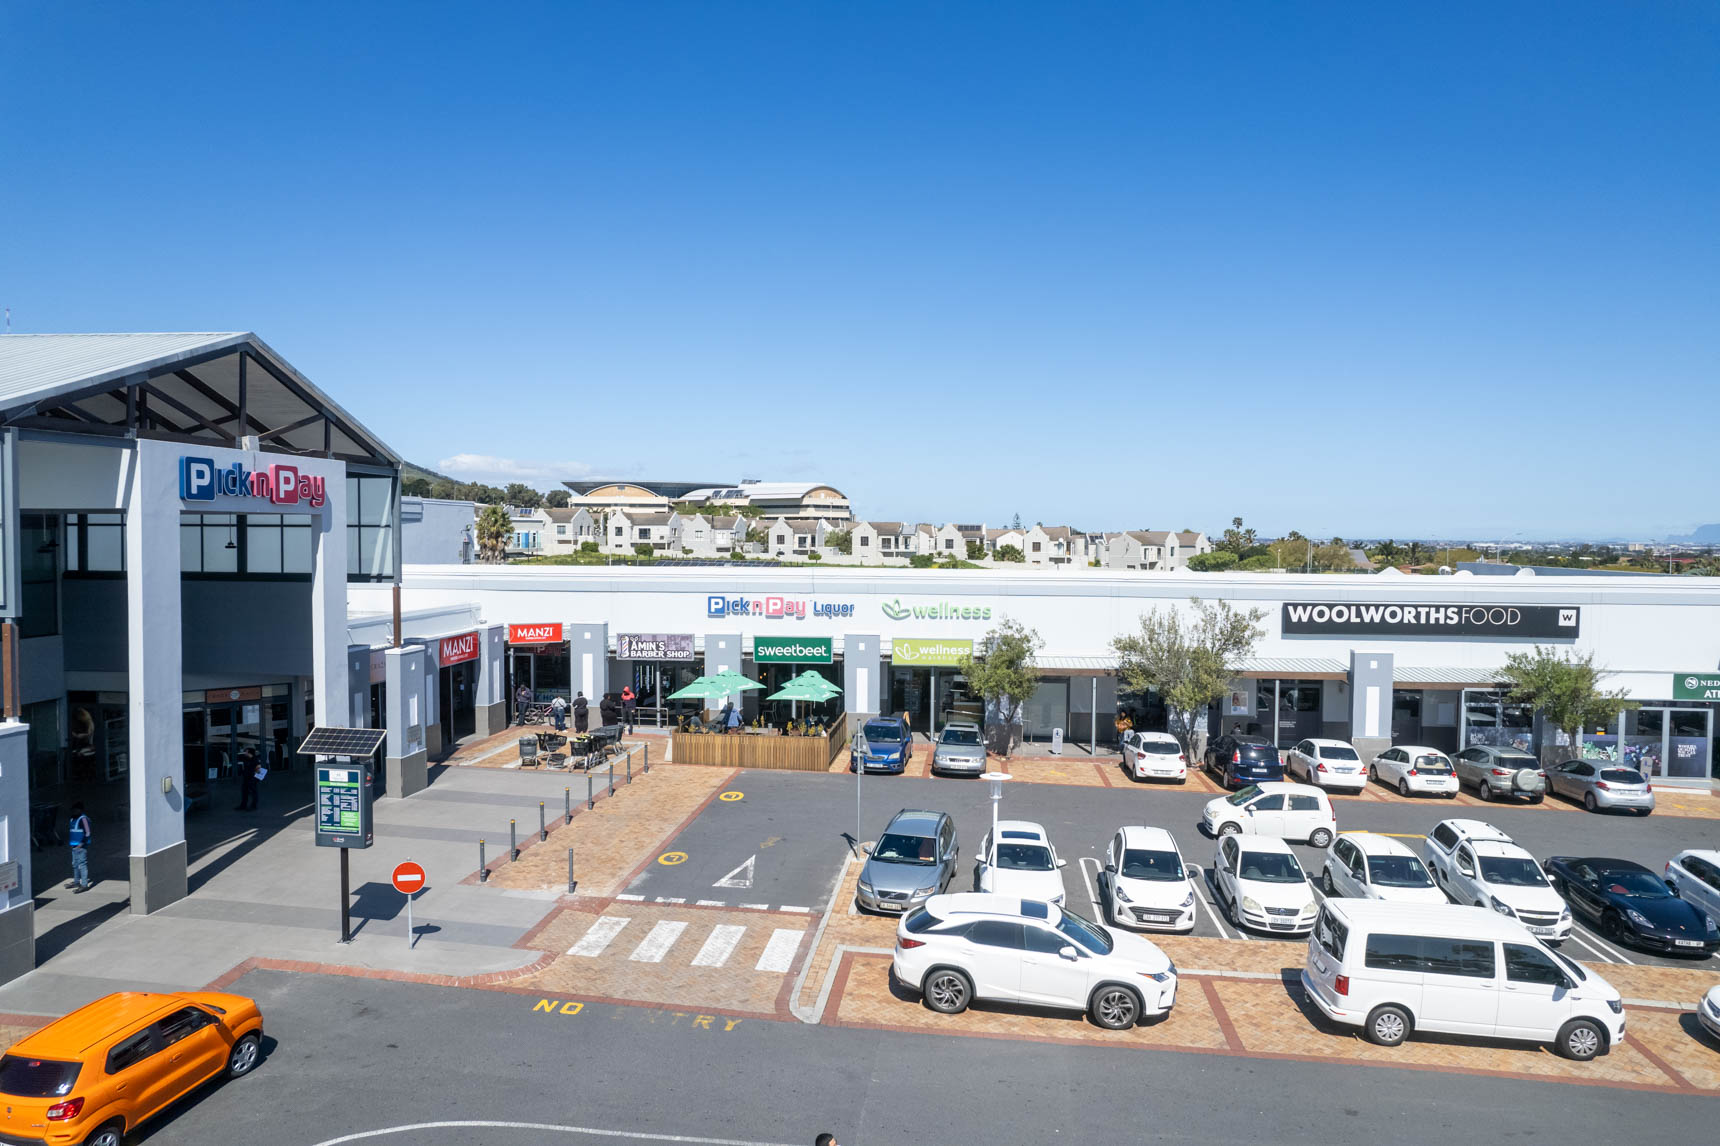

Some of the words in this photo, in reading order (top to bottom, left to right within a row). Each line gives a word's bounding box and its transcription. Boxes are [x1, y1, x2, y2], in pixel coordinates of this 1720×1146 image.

[184, 457, 251, 500] Pick
[271, 465, 326, 507] Pay
[708, 597, 749, 614] Pick
[752, 601, 763, 613] n
[766, 597, 806, 616] Pay
[813, 601, 855, 616] Liquor
[913, 600, 992, 619] wellness
[517, 627, 553, 638] MANZI
[443, 636, 474, 657] MANZI
[631, 641, 665, 651] AMIN'S
[920, 644, 970, 655] wellness
[630, 650, 665, 658] BARBER
[1704, 690, 1720, 698] AT
[532, 999, 585, 1015] NO
